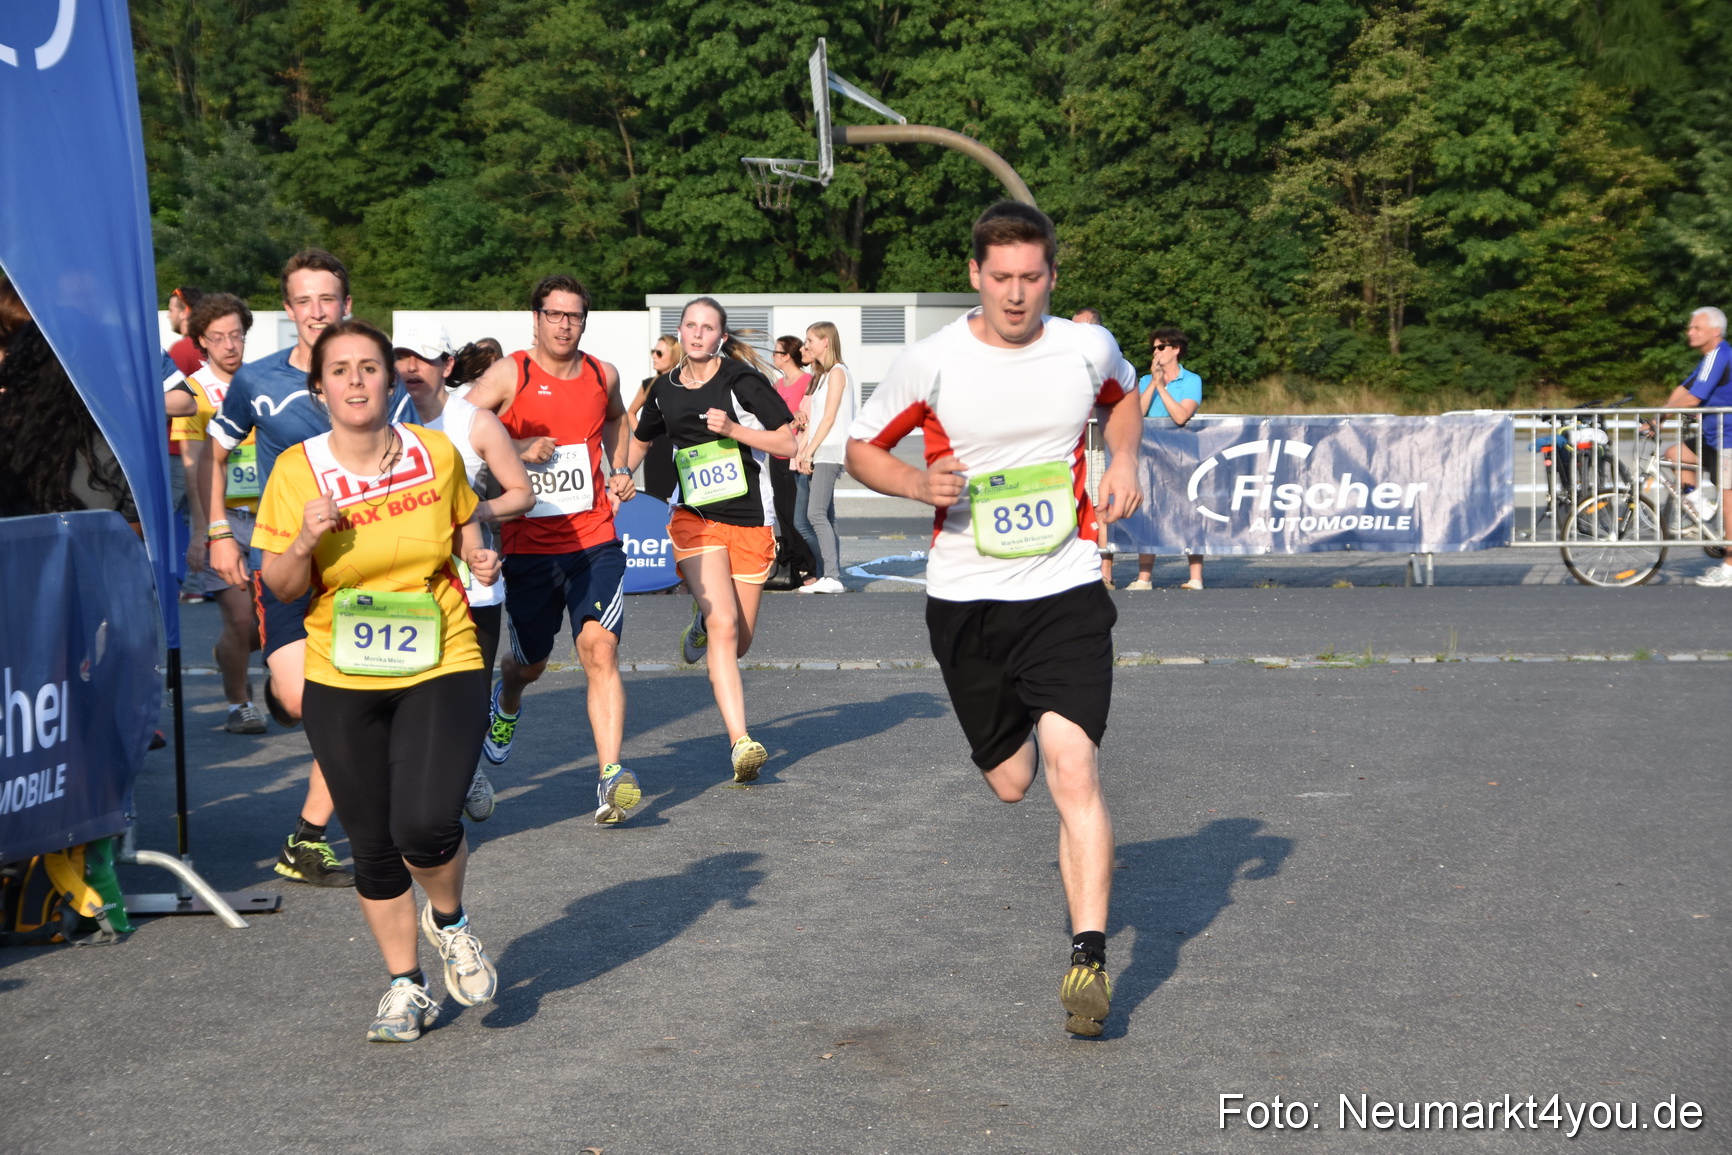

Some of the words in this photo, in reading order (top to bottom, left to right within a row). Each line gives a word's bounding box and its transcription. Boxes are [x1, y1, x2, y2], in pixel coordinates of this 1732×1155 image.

[232, 466, 256, 483] 93
[529, 468, 585, 496] 8920
[687, 462, 738, 490] 1083
[1231, 472, 1428, 511] Fischer
[329, 506, 382, 534] MAX
[387, 488, 442, 518] BÖGL
[993, 499, 1054, 534] 830
[1248, 515, 1412, 533] AUTOMOBILE
[621, 533, 673, 555] her
[626, 557, 667, 568] OBILE
[354, 622, 418, 653] 912
[364, 655, 387, 664] Monika
